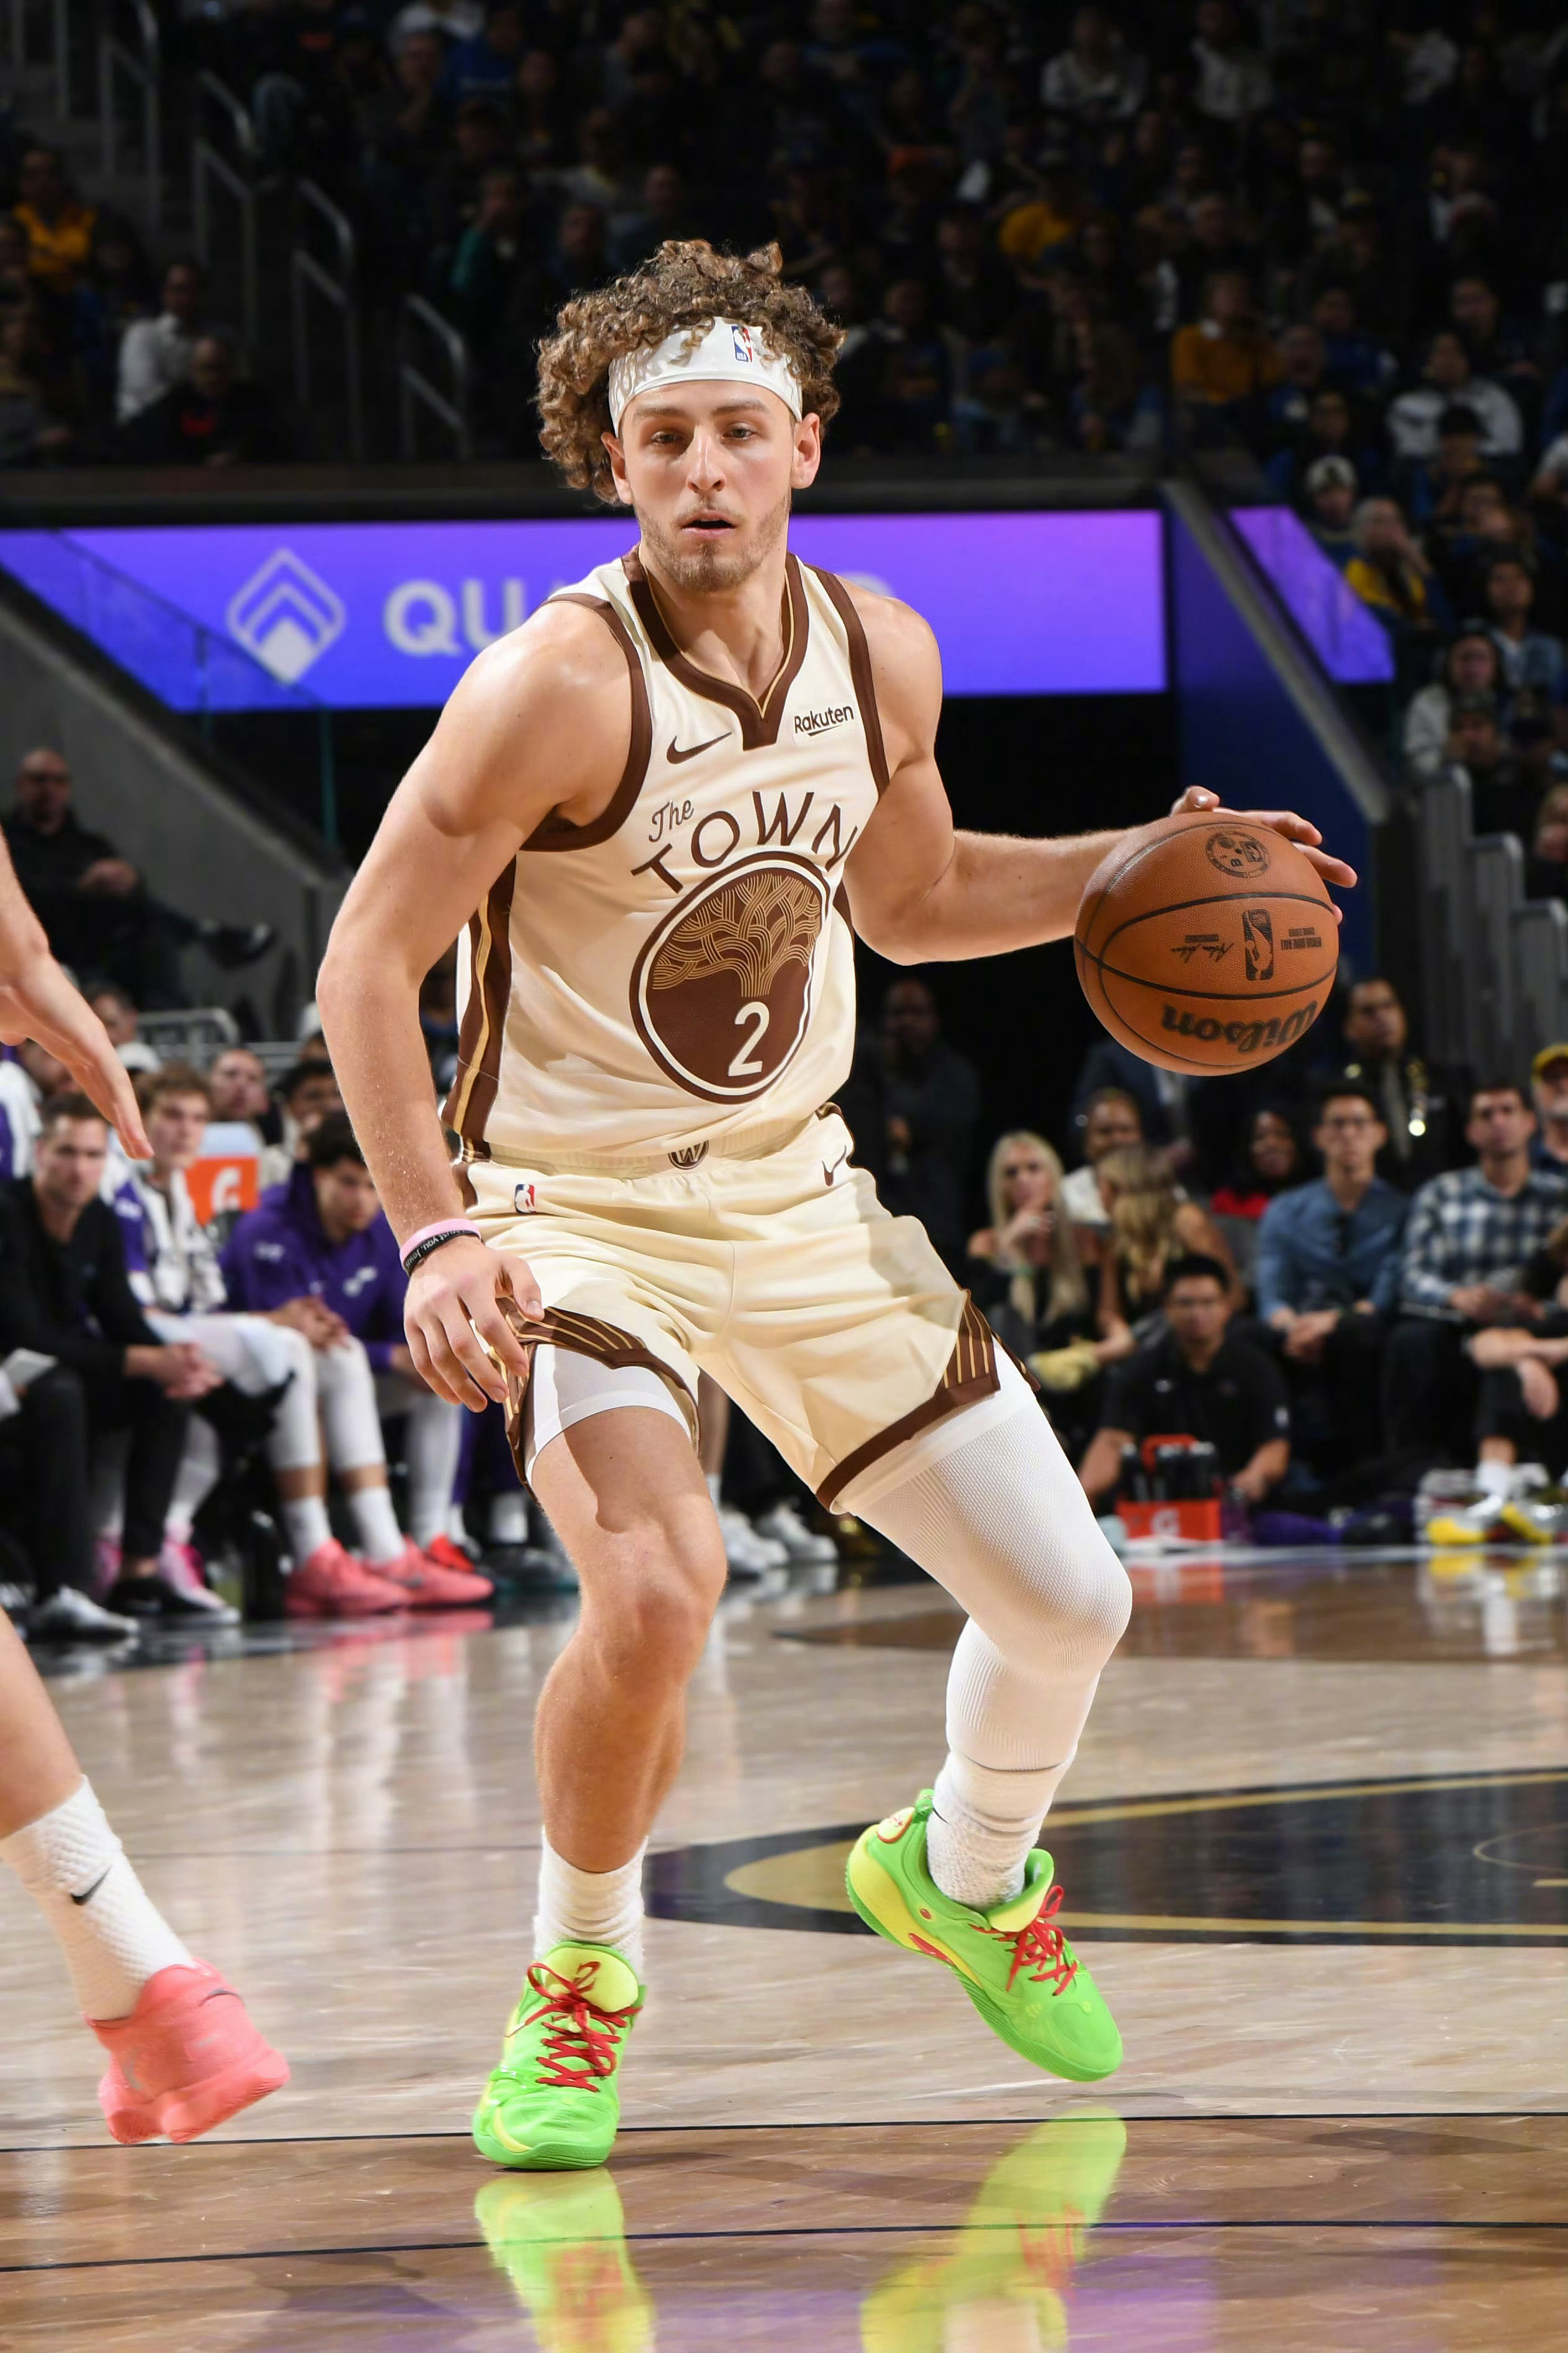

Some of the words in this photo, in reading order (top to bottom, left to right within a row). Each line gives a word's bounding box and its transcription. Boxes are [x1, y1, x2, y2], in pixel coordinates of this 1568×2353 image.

[794, 706, 854, 734] Rakuten
[630, 791, 858, 894] TOWN
[648, 799, 694, 843] The
[728, 1001, 770, 1077] 2
[1161, 1000, 1319, 1053] Wilson
[420, 1236, 439, 1251] you,
